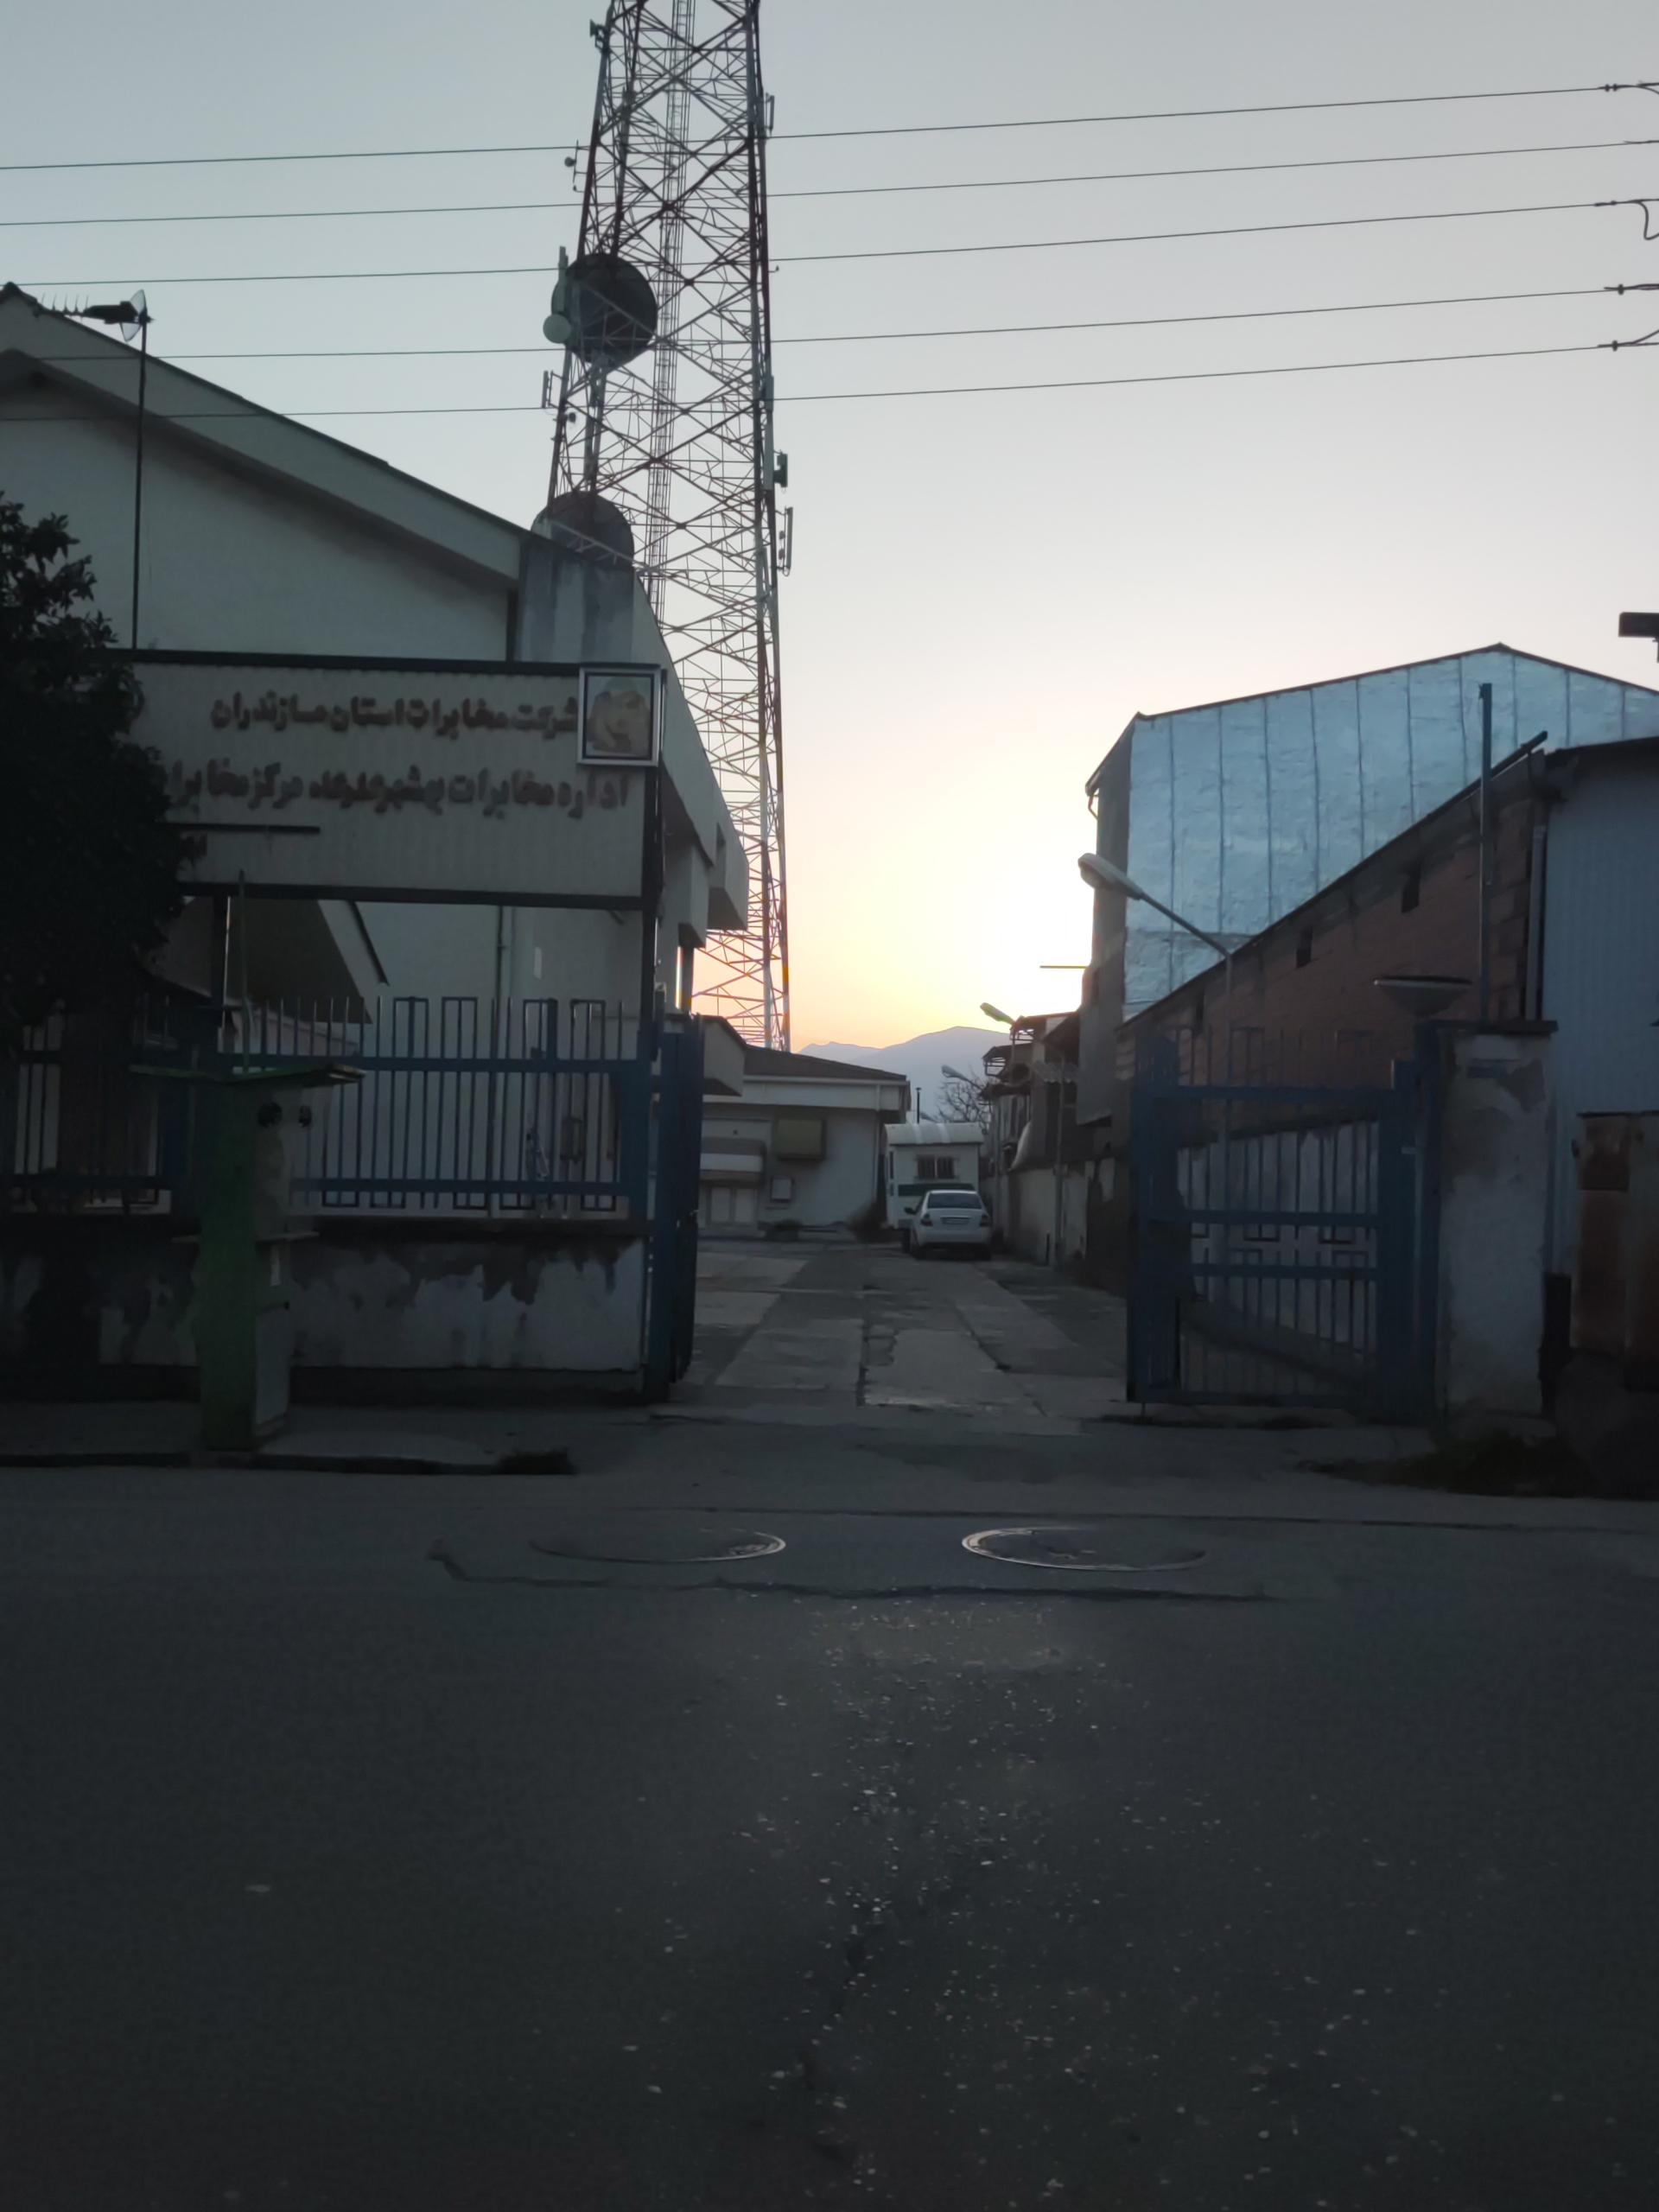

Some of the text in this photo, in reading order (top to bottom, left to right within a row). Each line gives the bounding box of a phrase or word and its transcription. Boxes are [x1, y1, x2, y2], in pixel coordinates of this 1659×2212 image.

[211, 689, 327, 730] مازندران
[330, 696, 404, 732] استان
[406, 696, 508, 740] مخابرات
[169, 757, 250, 815] مخابرا
[247, 761, 304, 810] مرکز
[448, 767, 555, 820] مخابرات
[557, 771, 630, 819] اداره
